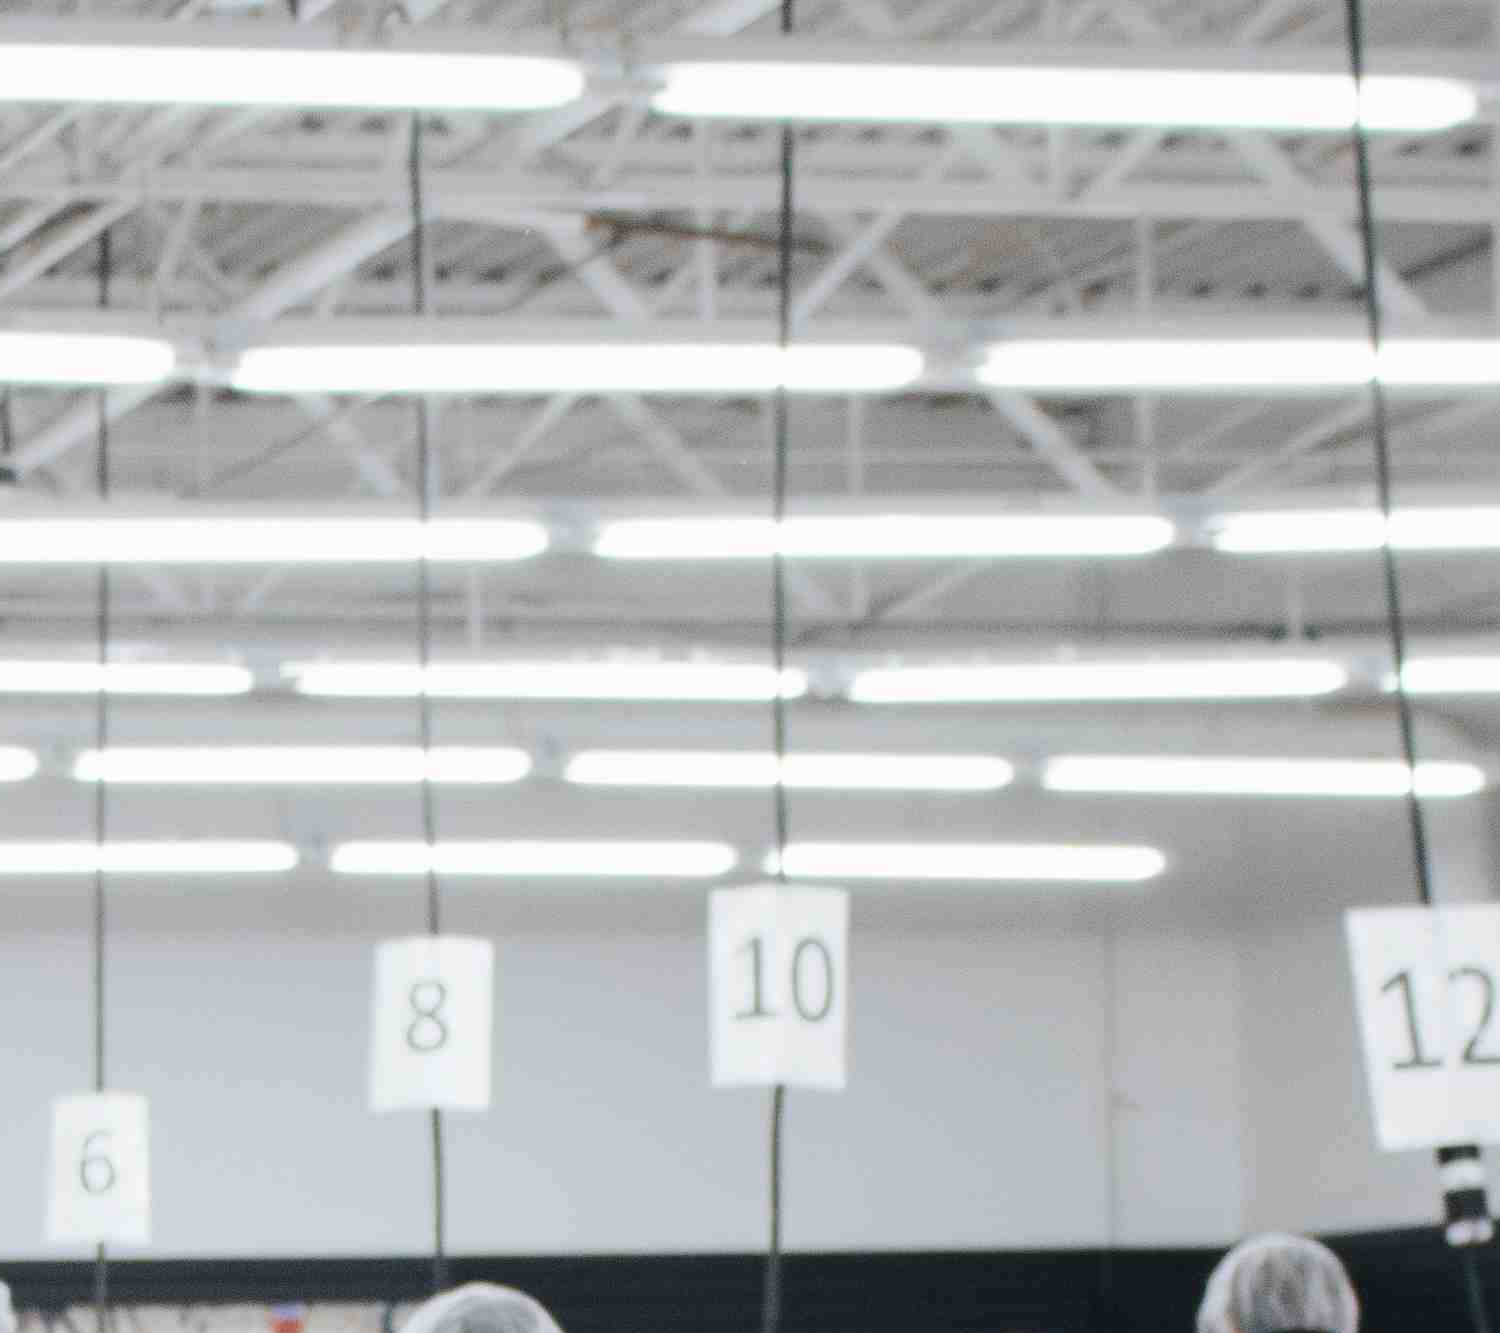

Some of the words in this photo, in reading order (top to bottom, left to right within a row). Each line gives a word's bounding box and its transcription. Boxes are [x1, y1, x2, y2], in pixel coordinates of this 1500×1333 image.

[734, 936, 836, 1023] 10
[403, 980, 450, 1054] 8
[78, 1131, 117, 1196] 6
